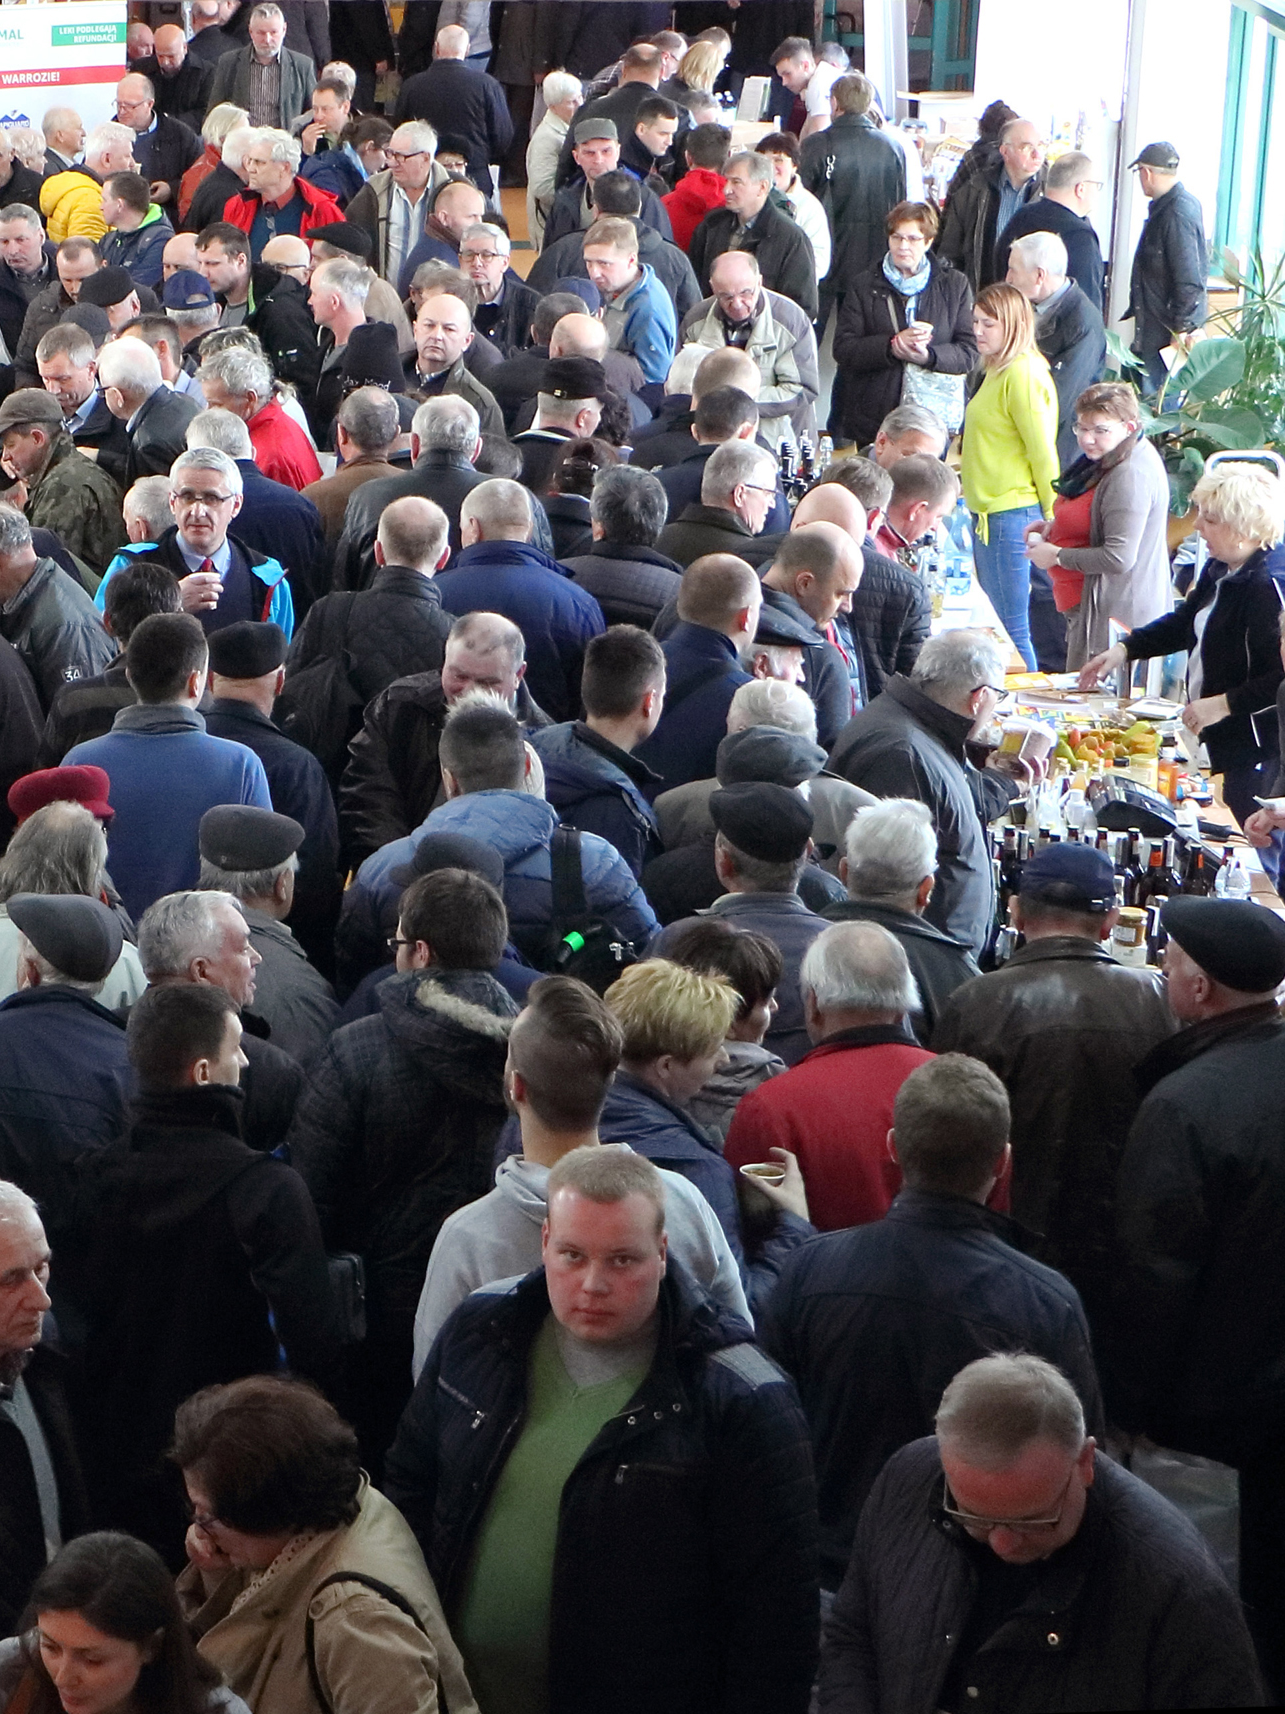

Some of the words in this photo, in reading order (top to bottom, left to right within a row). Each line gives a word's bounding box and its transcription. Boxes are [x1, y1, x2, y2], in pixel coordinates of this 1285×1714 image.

[59, 27, 75, 35] LEKI
[76, 25, 117, 35] PODLEGAJĄ
[74, 34, 117, 43] REFUNDACJI
[1, 72, 60, 85] WARROZIE!
[64, 668, 81, 682] 34
